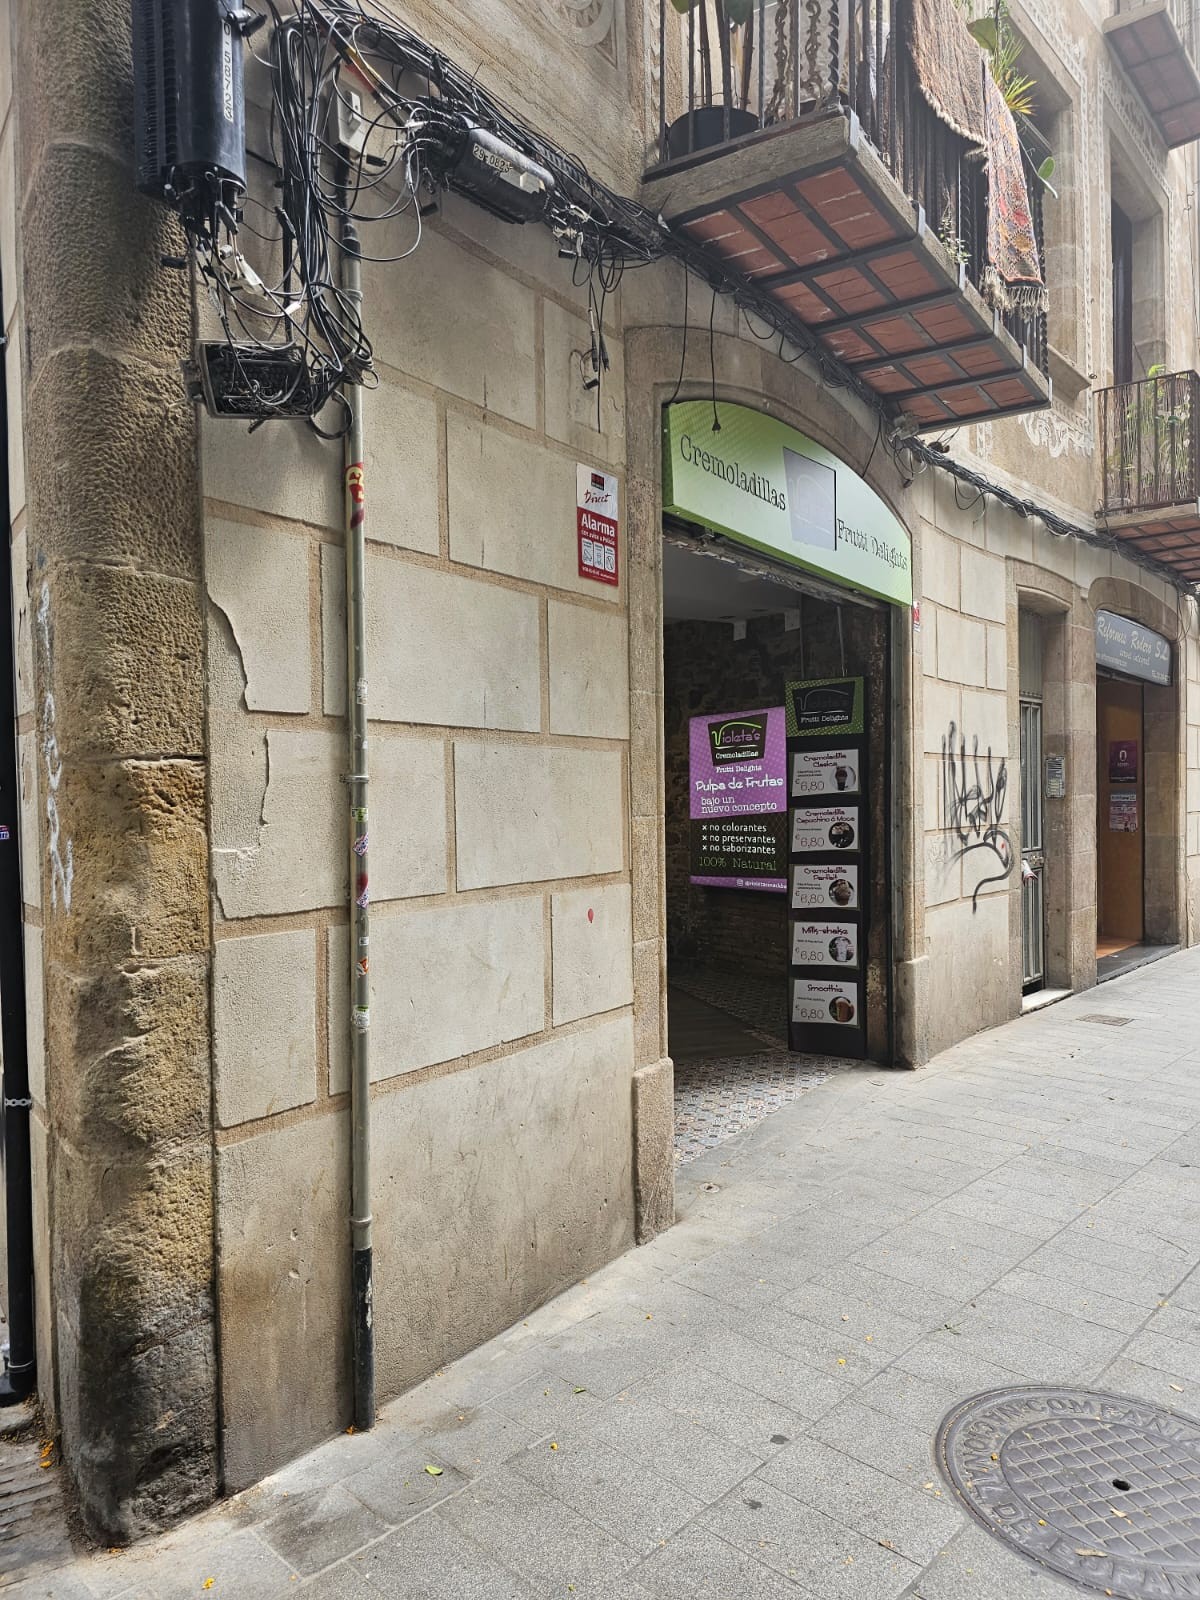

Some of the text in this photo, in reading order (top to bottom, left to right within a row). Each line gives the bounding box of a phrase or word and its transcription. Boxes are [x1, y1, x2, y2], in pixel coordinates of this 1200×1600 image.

[680, 434, 786, 511] Cremoladillas
[582, 513, 615, 537] Alarma
[837, 518, 908, 570] Frutti Delights
[821, 714, 849, 722] Delights
[712, 722, 762, 746] Violeta's
[715, 751, 759, 760] Cremoladillas
[716, 764, 762, 774] Frutti Delights
[695, 774, 784, 794] Pulpa de Frutas
[800, 780, 825, 792] 6,80
[701, 797, 720, 806] bajo
[701, 802, 777, 814] nuevo concepto
[722, 821, 767, 832] colorantes
[722, 835, 776, 844] preservantes
[801, 837, 825, 848] 6,80
[722, 843, 776, 855] saborizantes
[699, 856, 777, 871] 100% Natural
[801, 894, 824, 905] 6,80
[801, 950, 824, 962] 6,80
[807, 984, 843, 993] Smoothie
[801, 1008, 824, 1020] 6,80
